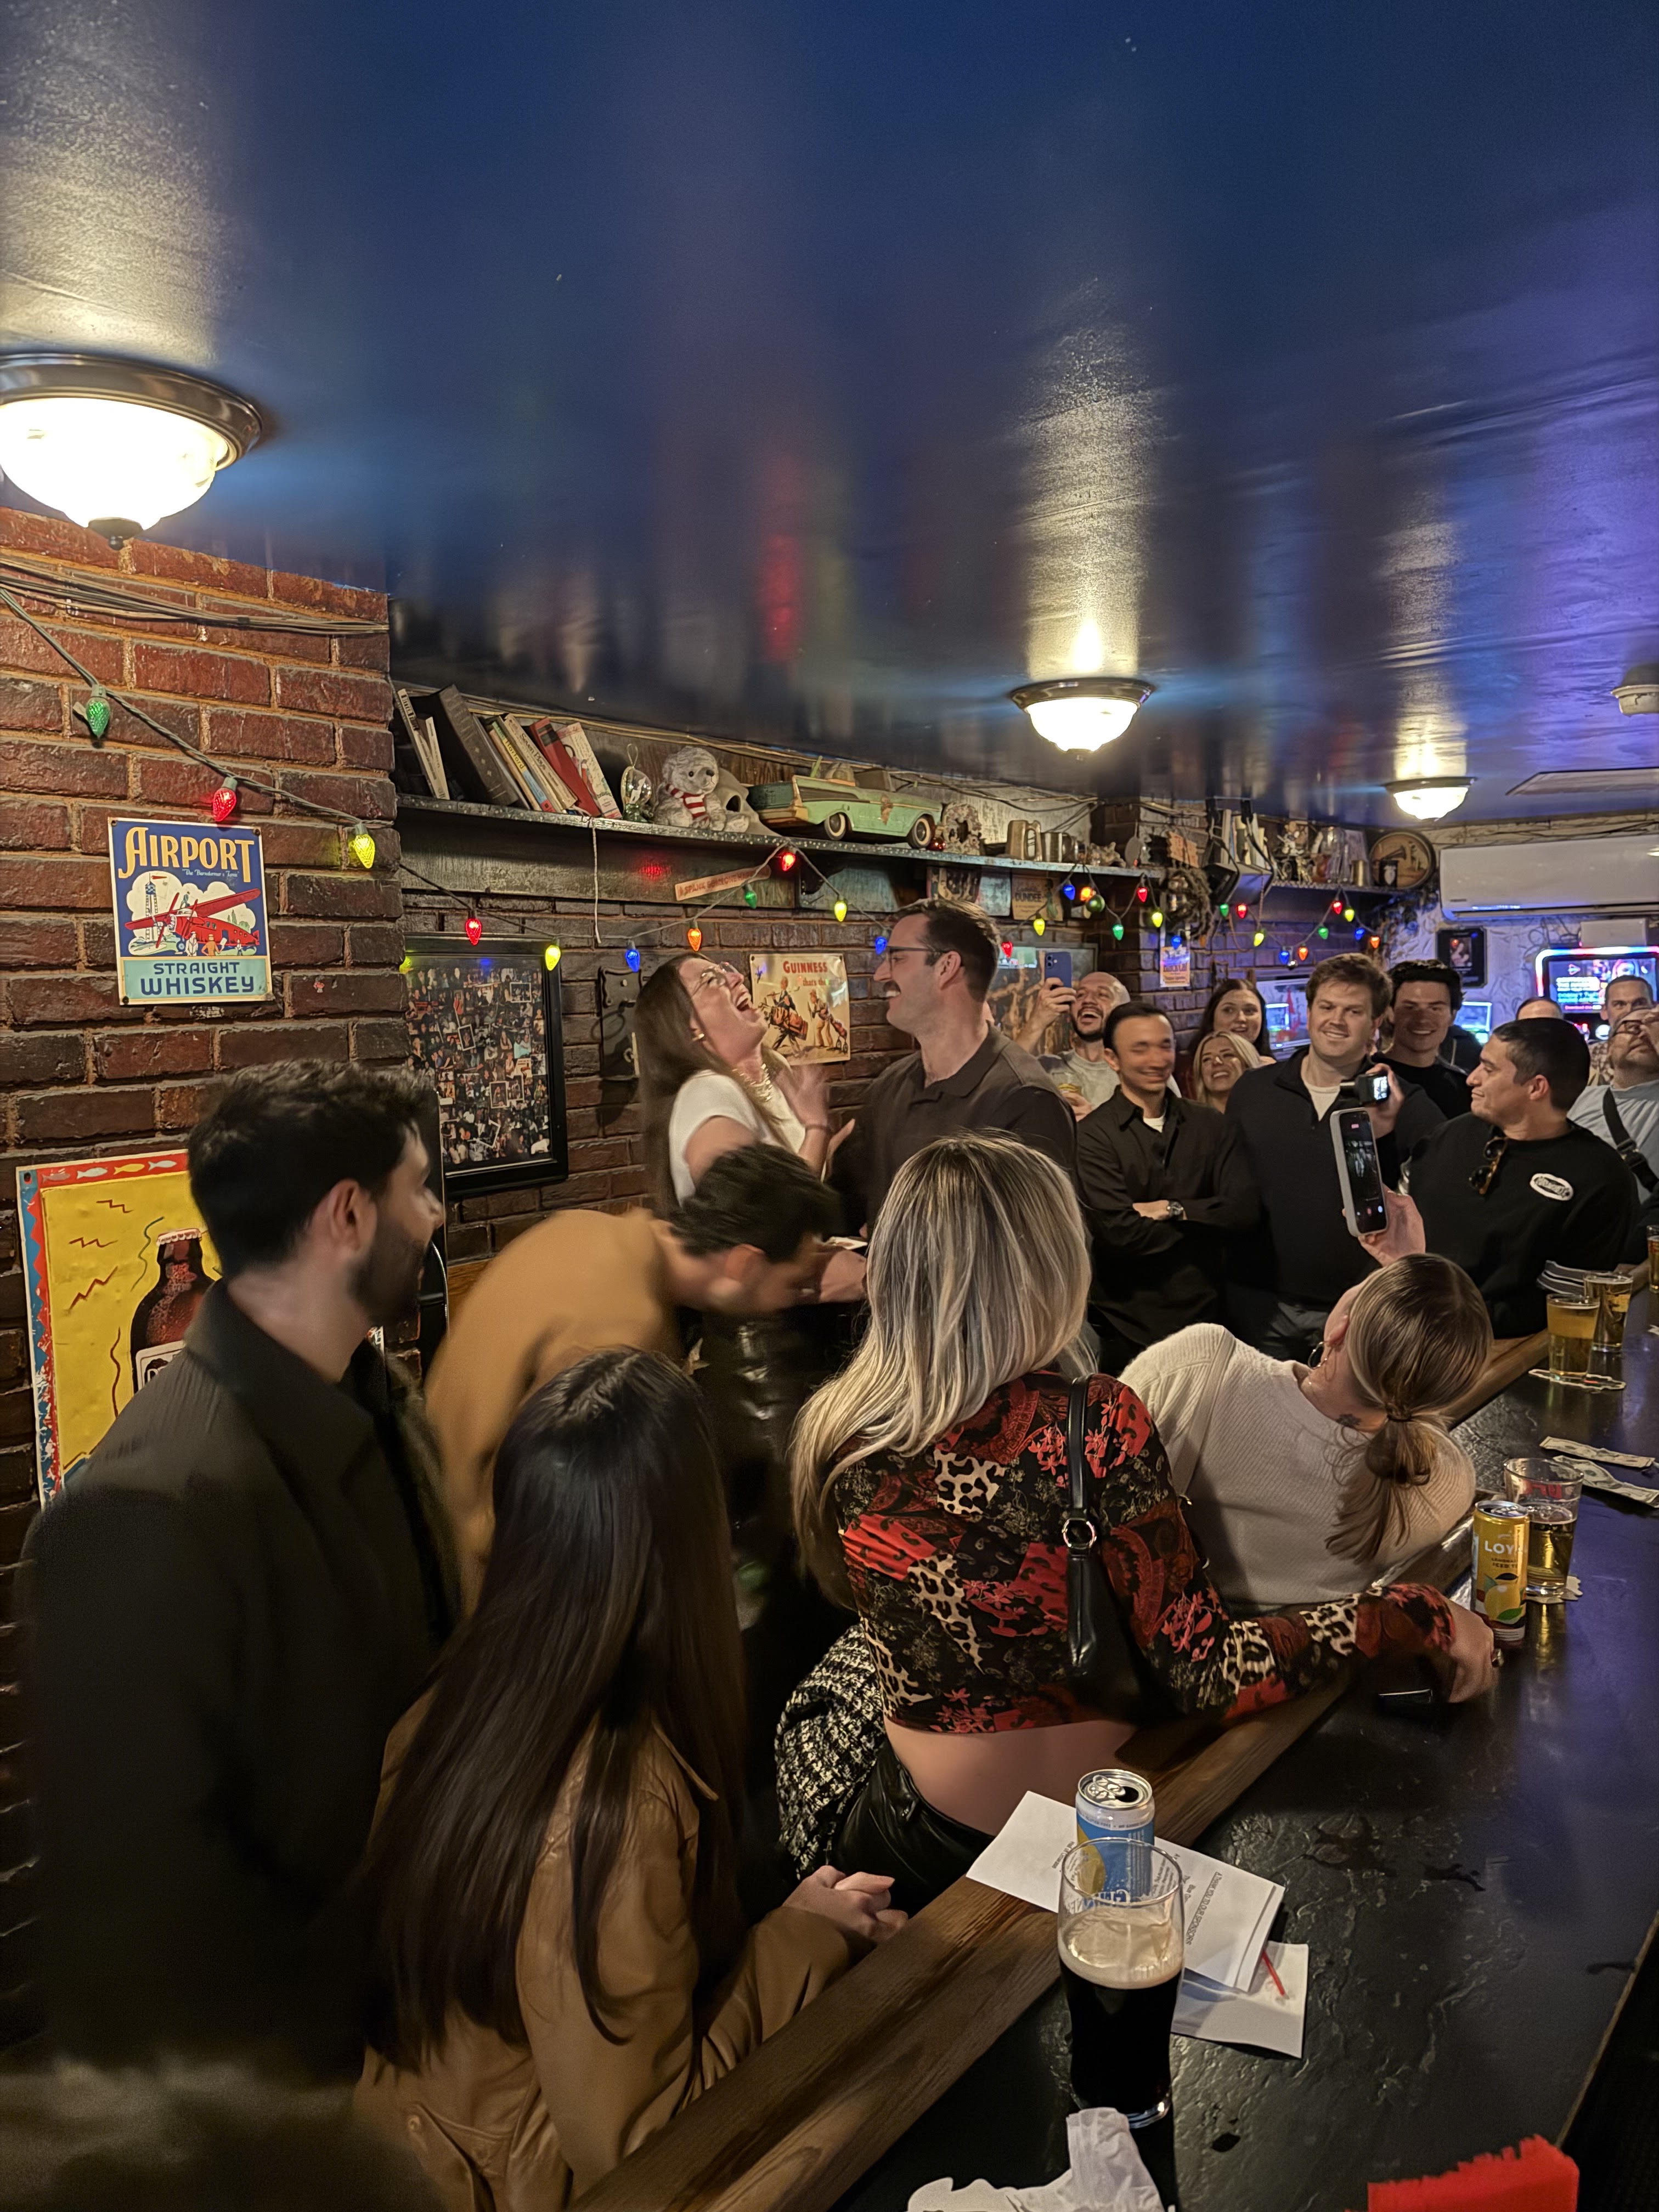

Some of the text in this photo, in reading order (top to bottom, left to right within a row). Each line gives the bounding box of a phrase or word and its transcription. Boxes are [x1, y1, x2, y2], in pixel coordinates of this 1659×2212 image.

[118, 826, 255, 883] AIRPORT
[153, 962, 240, 975] STRAIGHT
[783, 961, 828, 974] GUINNESS
[140, 976, 254, 996] WHISKEY
[1485, 1540, 1522, 1555] LOY
[1186, 1916, 1203, 1946] SPONSORS
